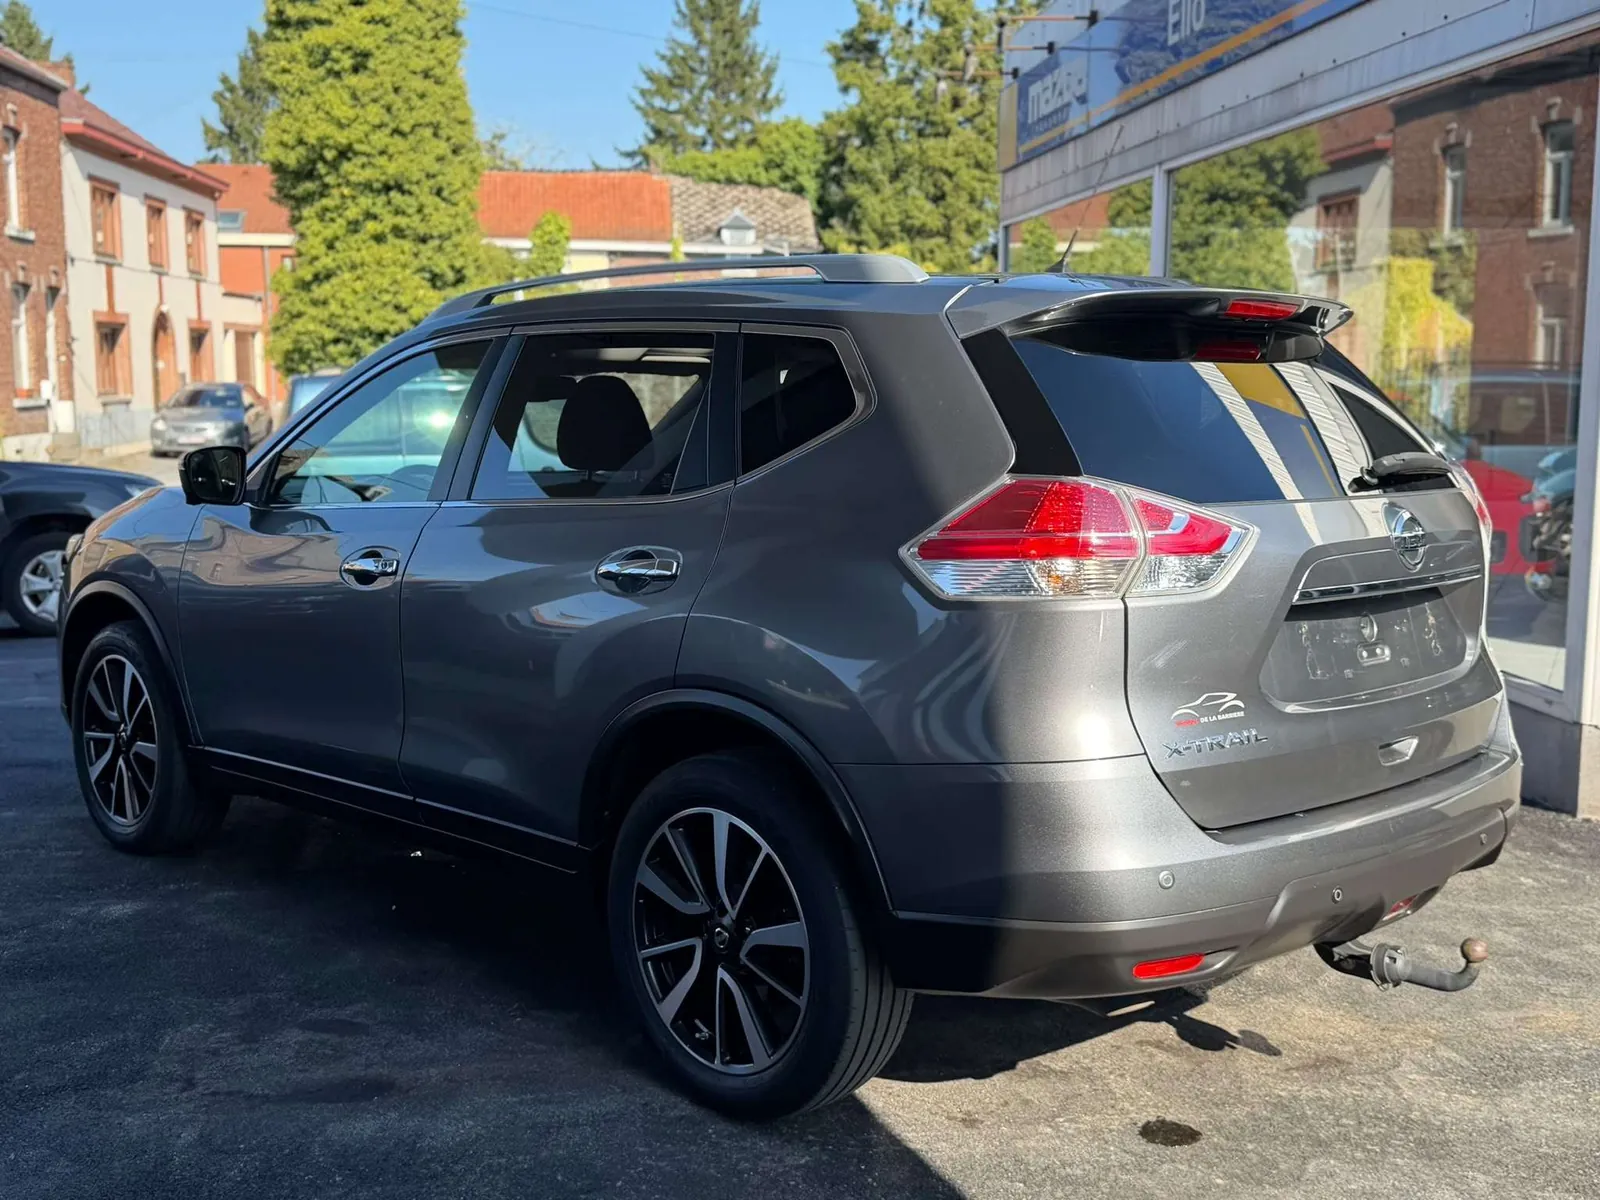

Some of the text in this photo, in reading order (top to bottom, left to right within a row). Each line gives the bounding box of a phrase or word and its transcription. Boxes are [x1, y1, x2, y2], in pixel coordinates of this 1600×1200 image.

[1200, 715, 1209, 724] DE
[1209, 714, 1218, 722] LA
[1162, 728, 1268, 759] X-TRAIL
